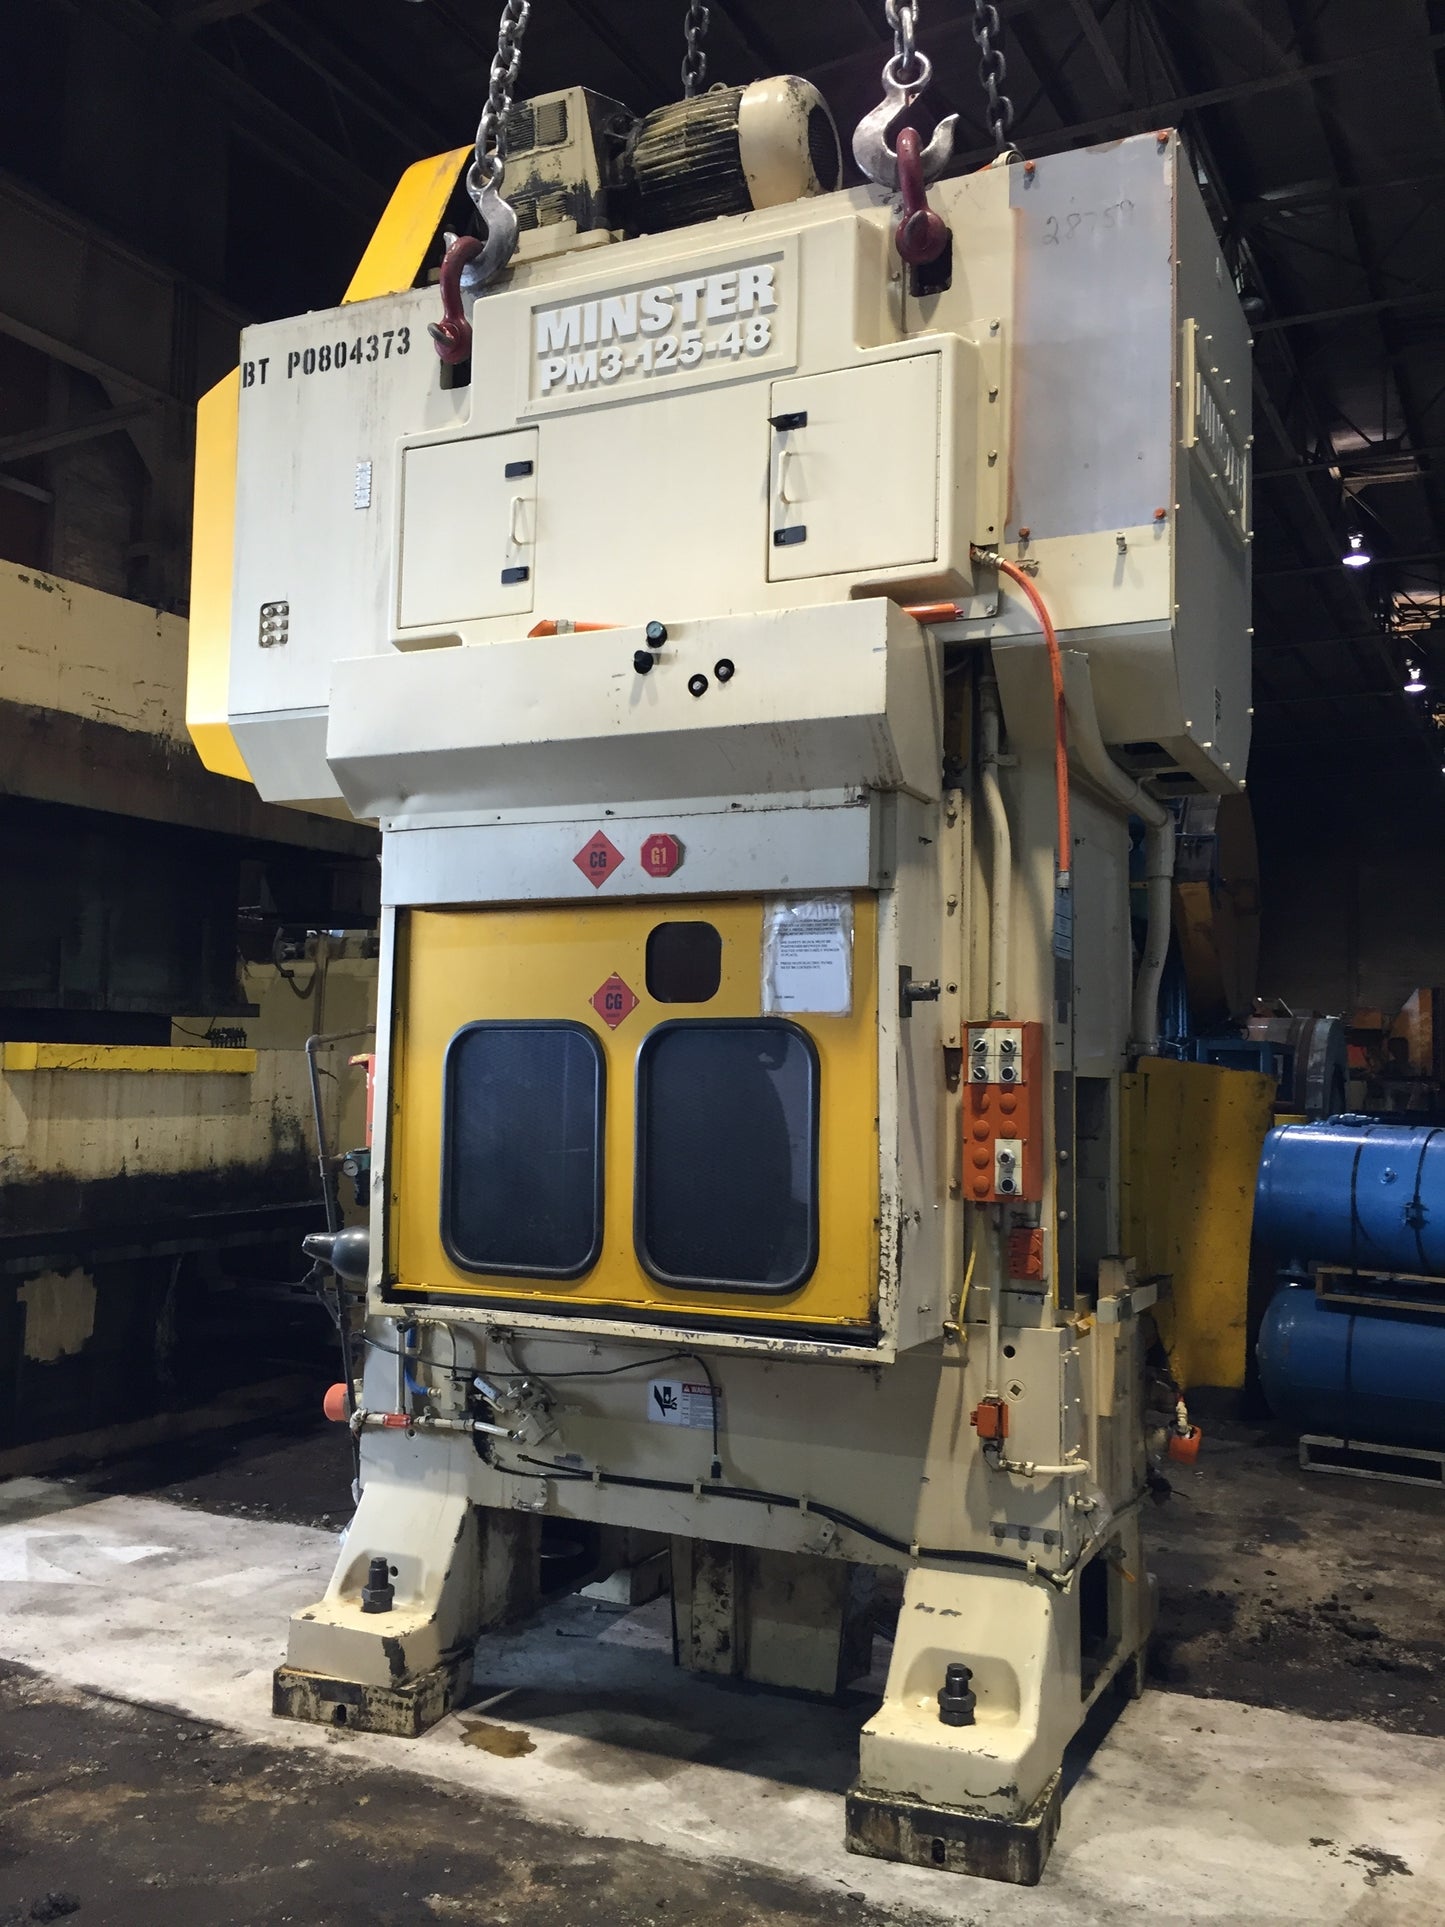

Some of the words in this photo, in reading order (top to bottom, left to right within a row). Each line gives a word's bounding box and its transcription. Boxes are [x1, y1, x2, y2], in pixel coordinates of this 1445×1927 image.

[537, 264, 776, 352] MINSTER
[242, 358, 270, 388] BT
[288, 327, 411, 379] P0804373
[541, 316, 771, 391] PM3-125-48
[590, 851, 607, 868] CG
[651, 847, 667, 865] G1
[605, 993, 622, 1010] CG
